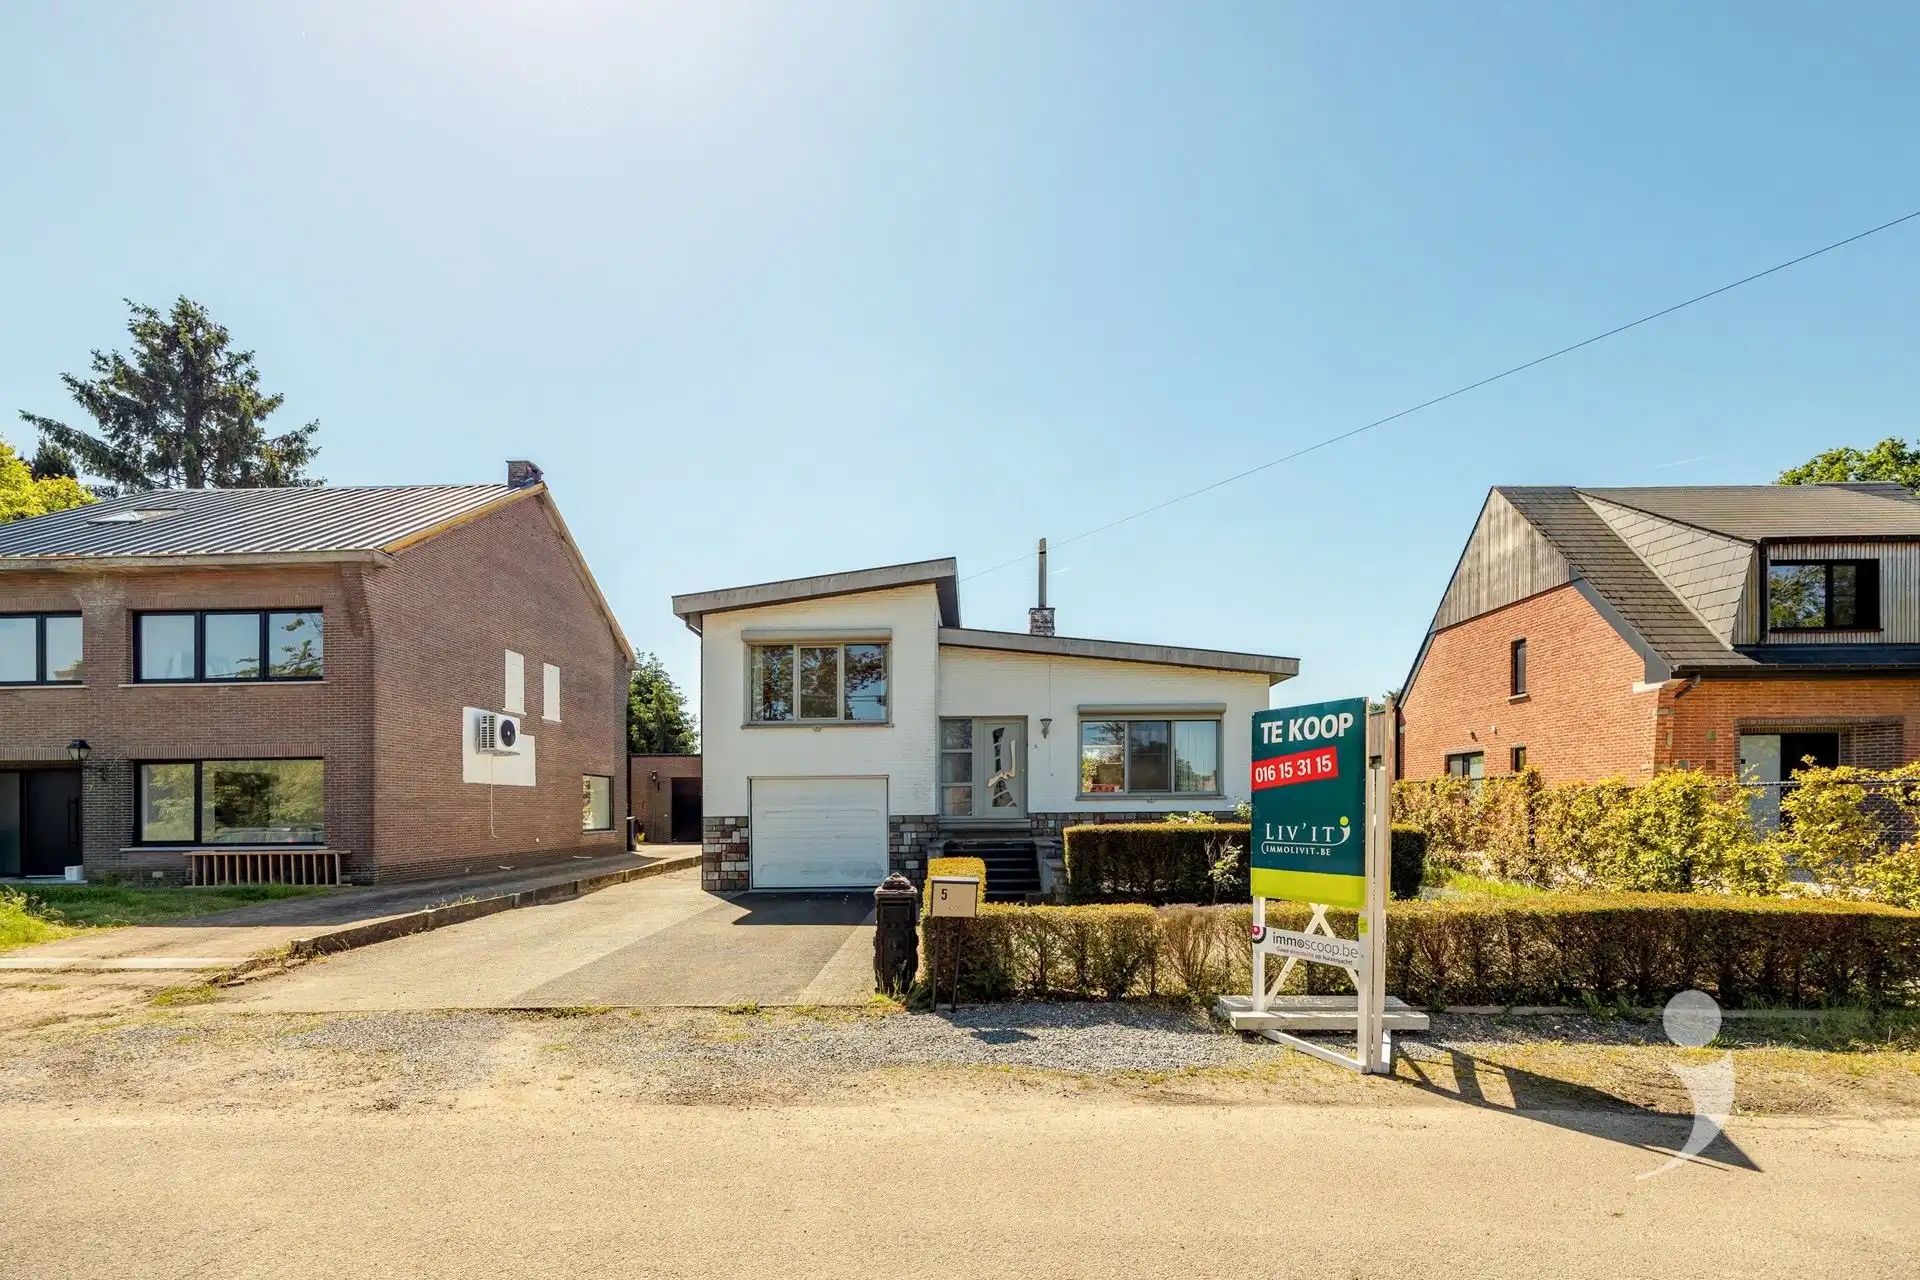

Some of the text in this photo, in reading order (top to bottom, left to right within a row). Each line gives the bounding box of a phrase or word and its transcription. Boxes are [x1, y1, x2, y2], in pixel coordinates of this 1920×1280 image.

[1260, 712, 1354, 744] TE KOOP
[1255, 754, 1332, 783] 016 15 31 15
[1265, 845, 1331, 856] IMMOLIVIT.BE
[941, 888, 948, 900] 5
[1272, 932, 1359, 959] immoscoop.be
